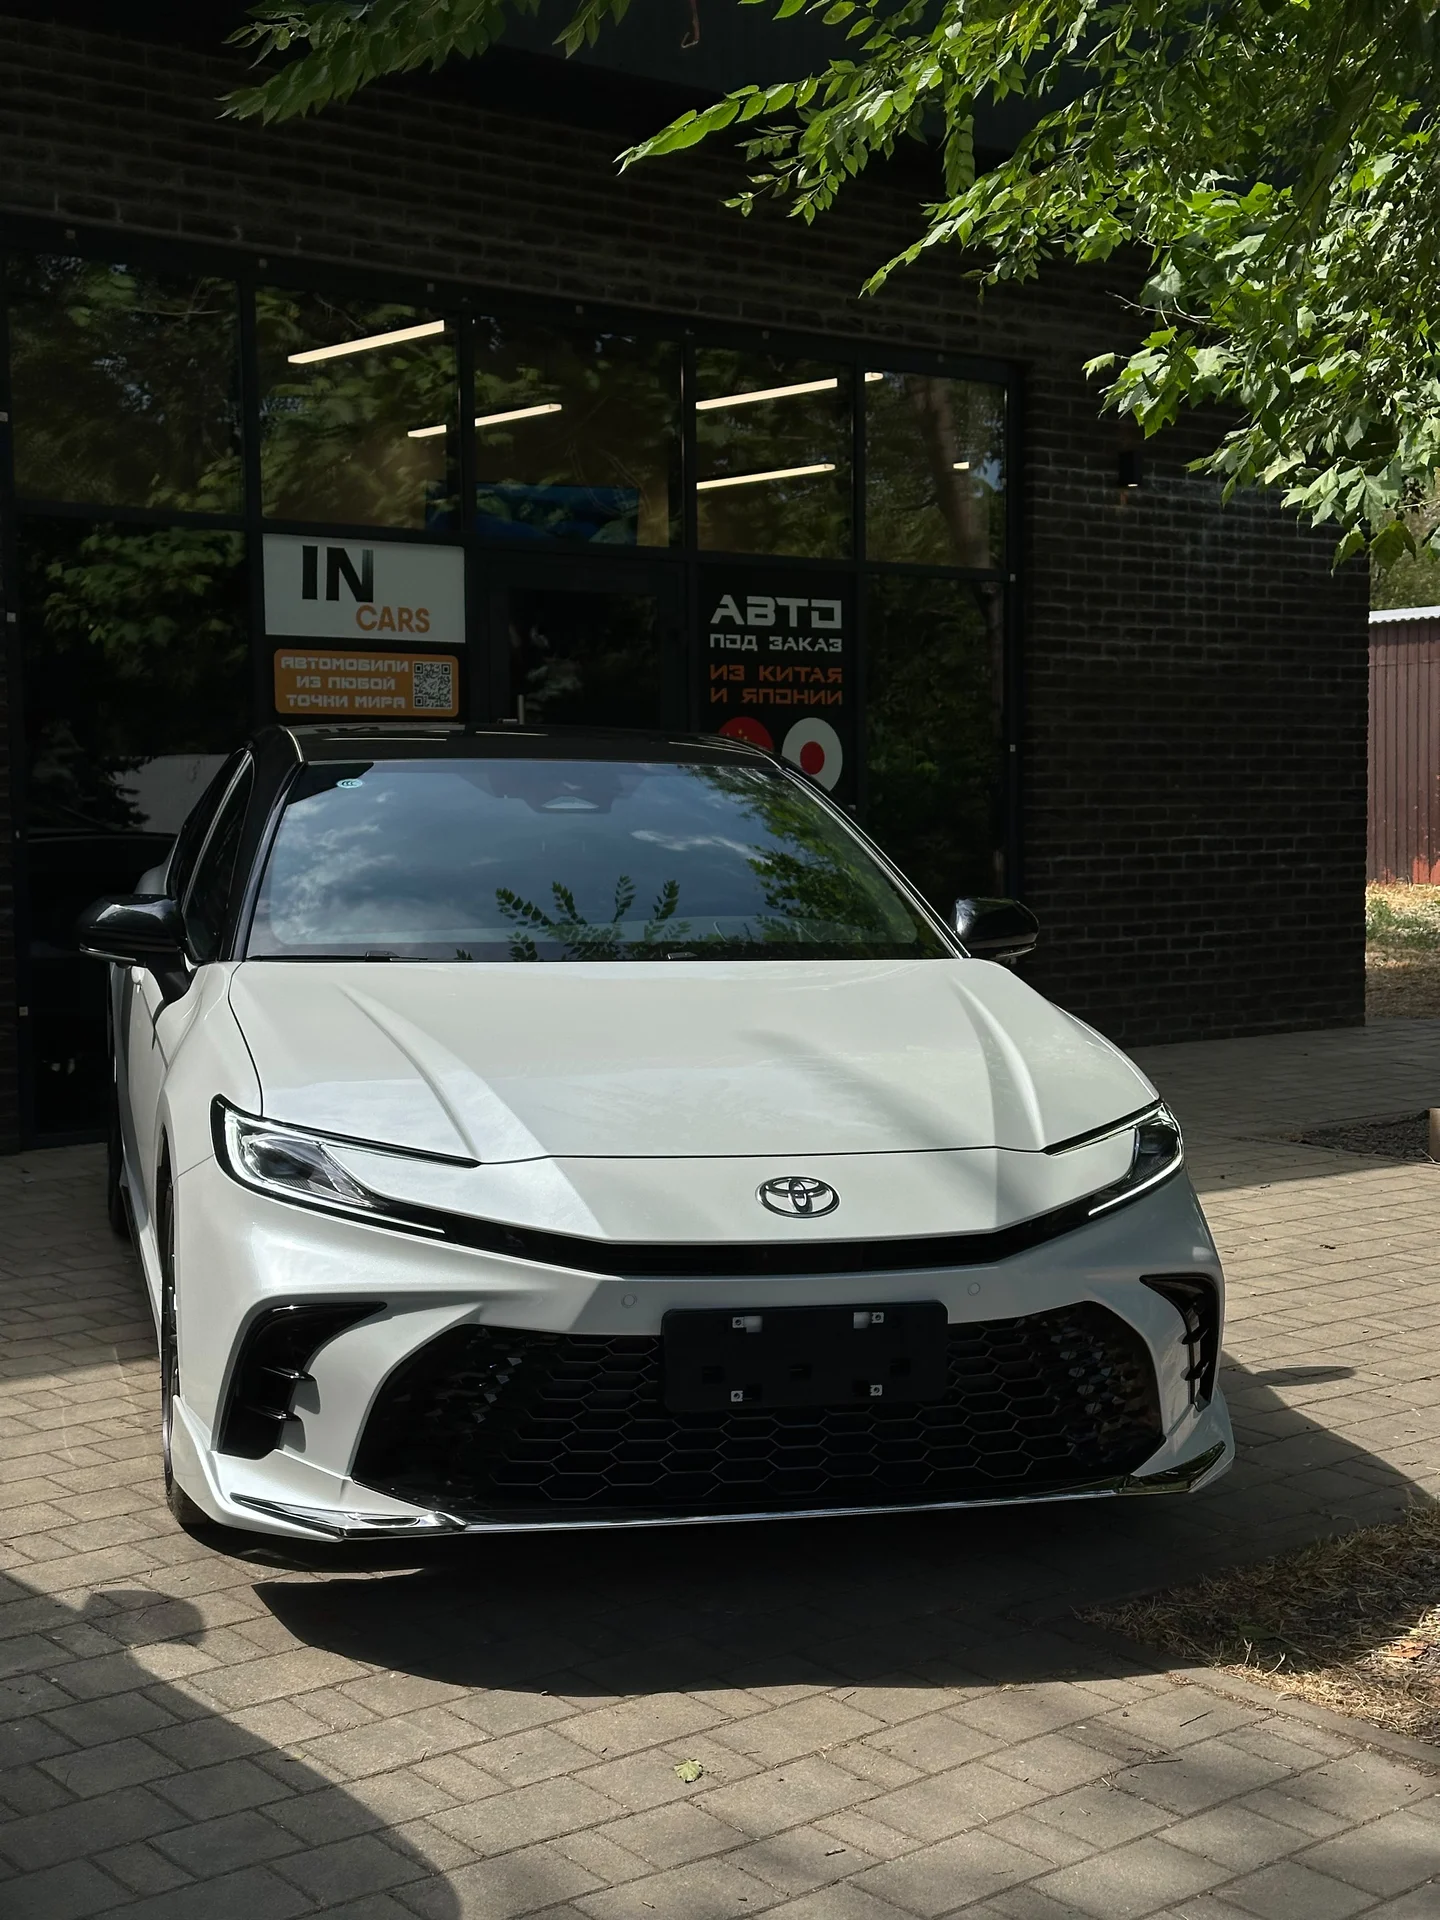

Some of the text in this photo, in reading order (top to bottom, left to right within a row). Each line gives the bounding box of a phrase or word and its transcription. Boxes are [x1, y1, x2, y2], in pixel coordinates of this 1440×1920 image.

[302, 545, 373, 602] IN
[356, 604, 429, 633] CARS
[710, 594, 842, 629] АВТО
[710, 634, 842, 652] ПОД ЗАКАЗ
[296, 676, 321, 688] ИЗ
[710, 664, 842, 684] ИЗ КИТАЯ
[286, 694, 406, 709] ТОЧКИ МИРА
[710, 687, 843, 705] И ЯПОНИИ
